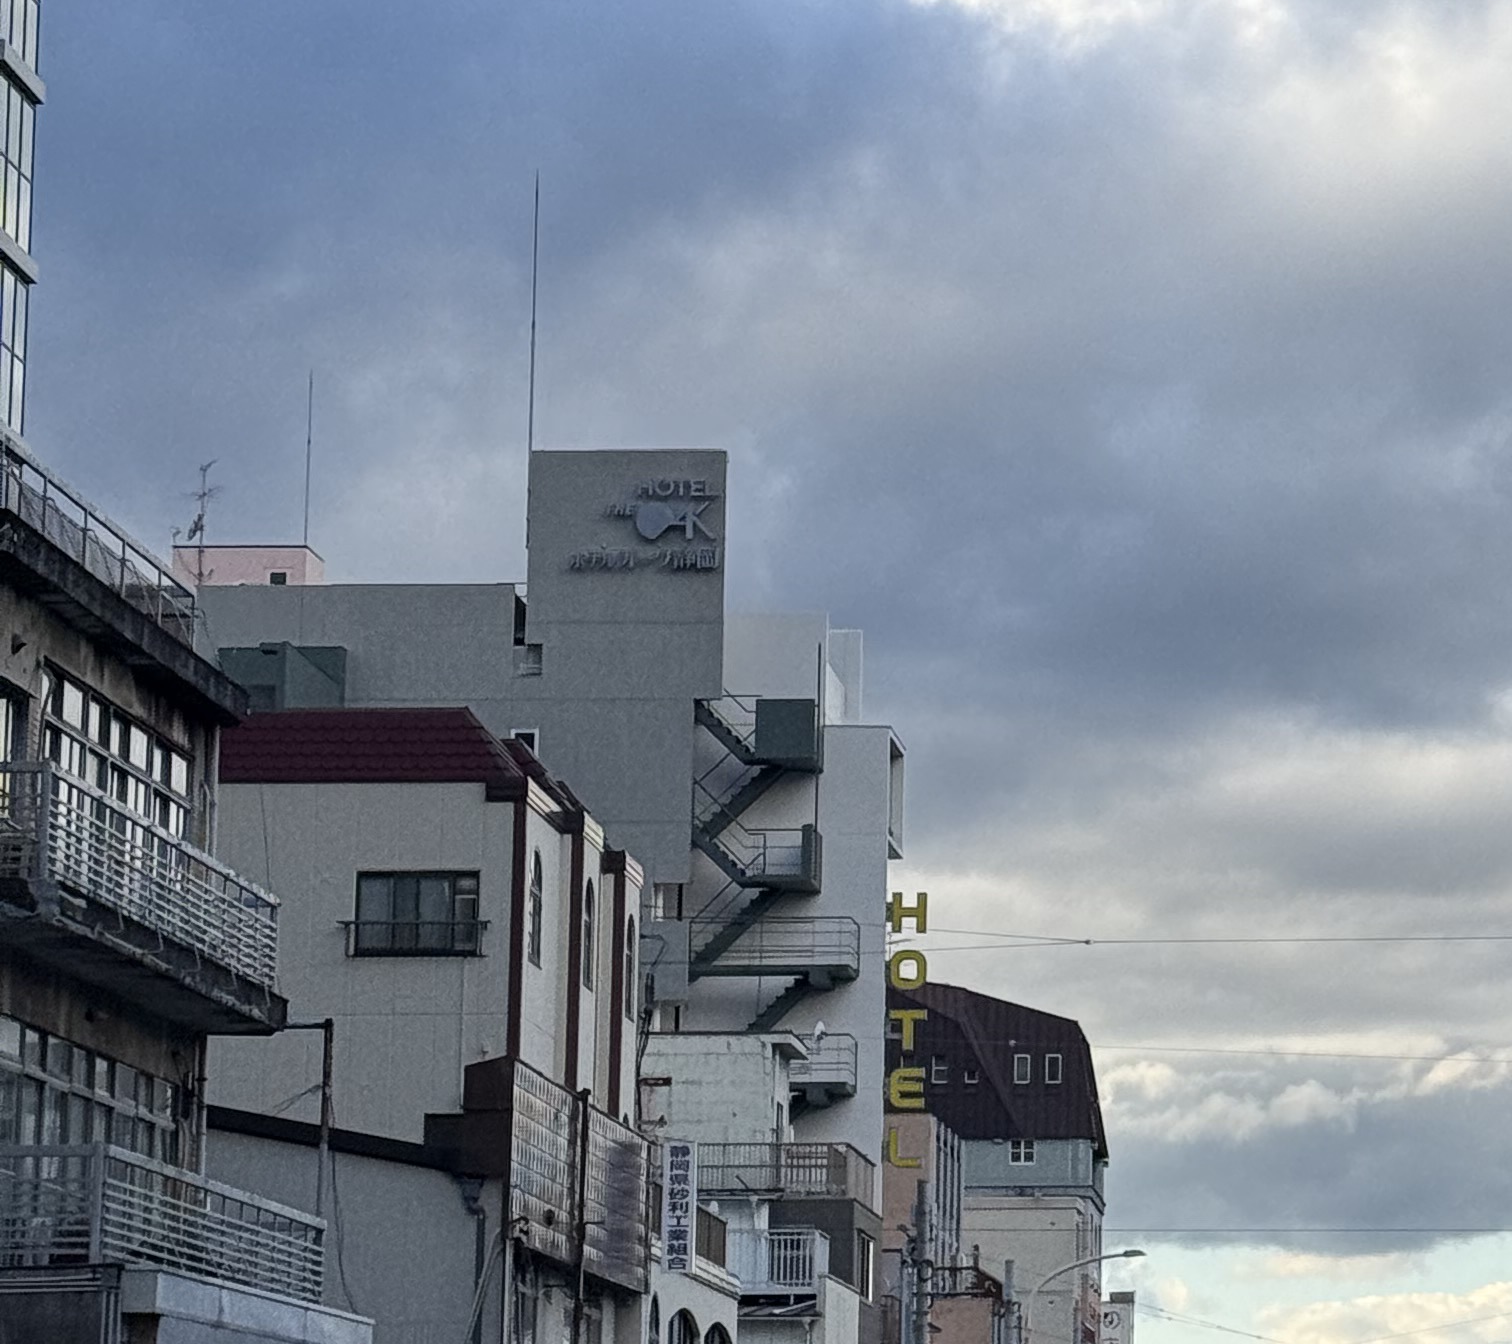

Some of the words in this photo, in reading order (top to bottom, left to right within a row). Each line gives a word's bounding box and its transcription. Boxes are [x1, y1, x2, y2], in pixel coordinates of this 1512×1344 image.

[638, 479, 720, 497] HOTEL
[889, 892, 927, 1168] HOTEL
[667, 1146, 690, 1270] 静岡県砂利工業組合
